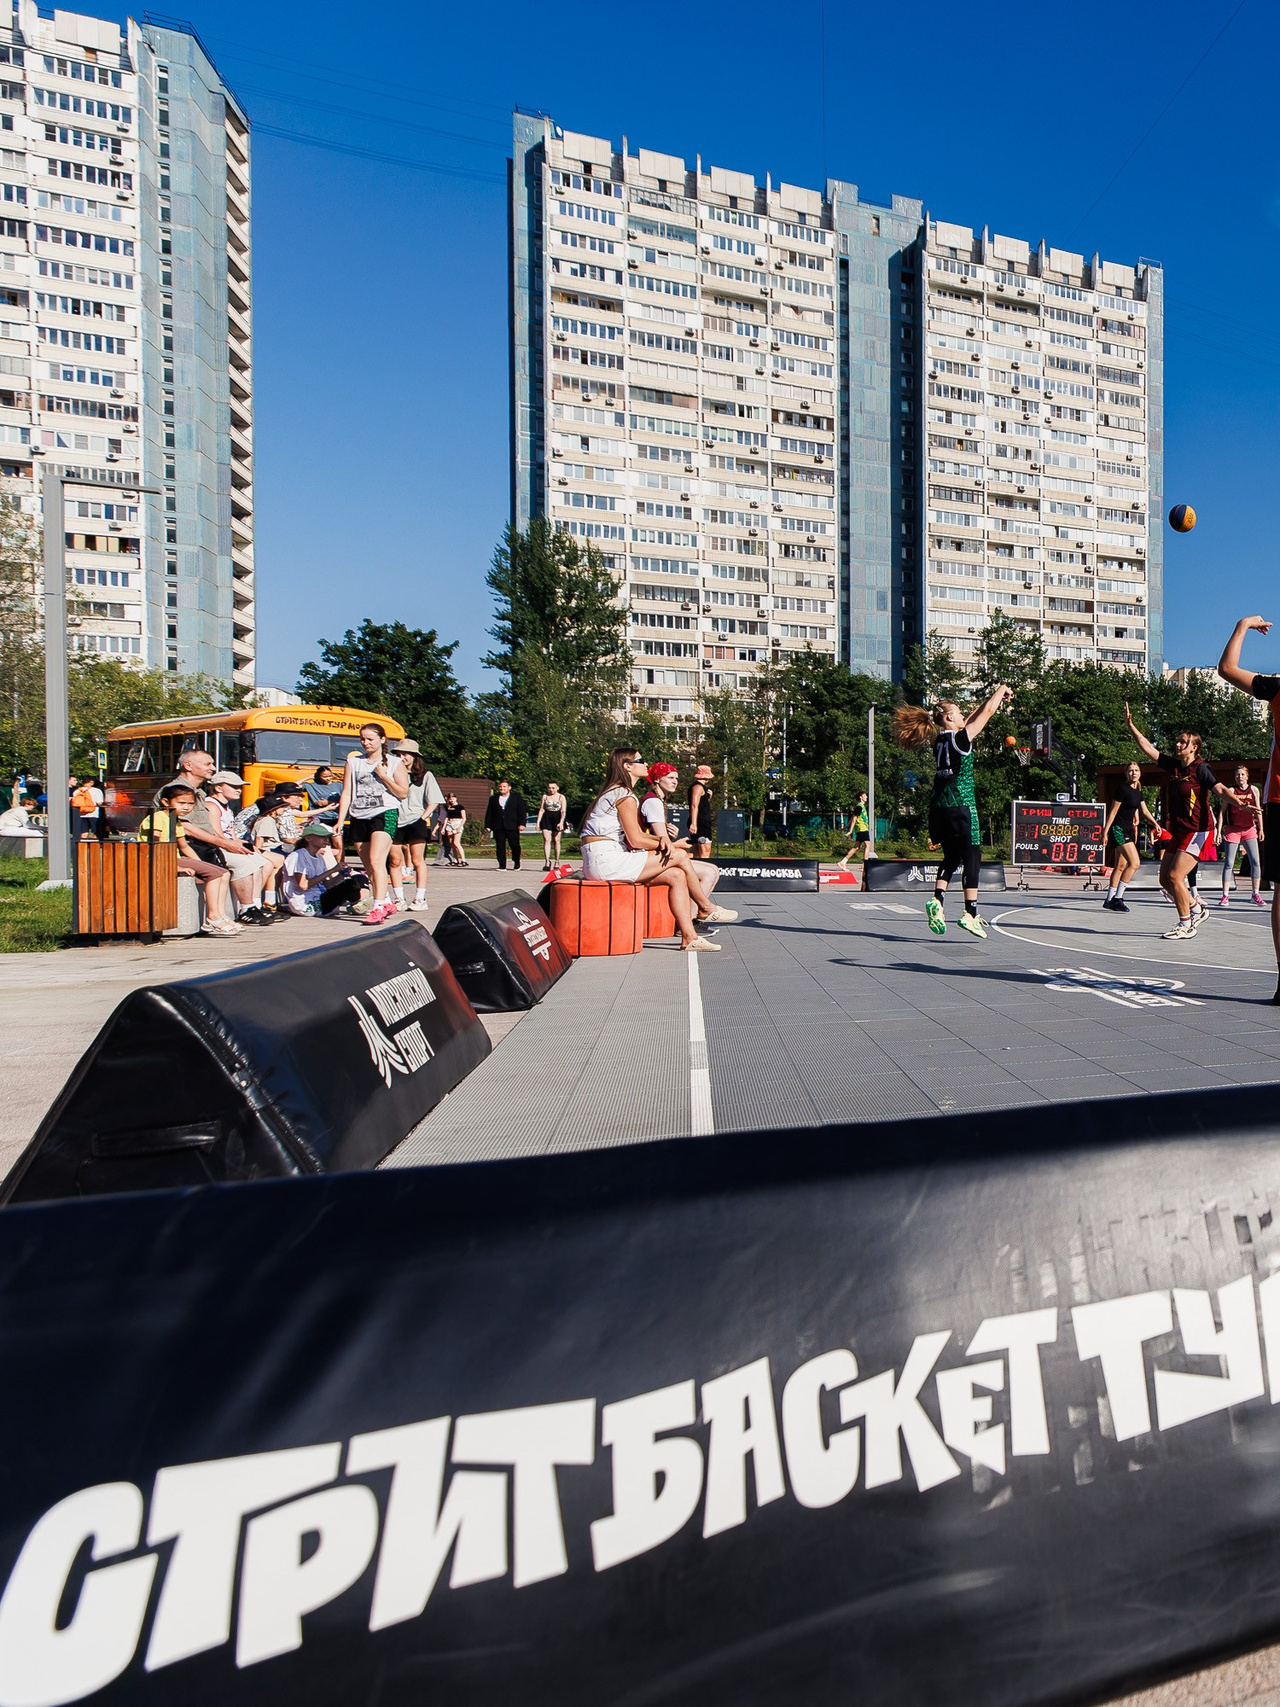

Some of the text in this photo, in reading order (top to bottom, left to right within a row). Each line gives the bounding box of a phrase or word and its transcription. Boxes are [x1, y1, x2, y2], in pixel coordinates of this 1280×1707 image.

[327, 720, 347, 729] ТУР
[1022, 808, 1098, 818] ТРИШ СТРМ
[1051, 817, 1071, 825] TIME
[1049, 835, 1072, 843] SHOT
[737, 867, 761, 878] ТУР
[761, 868, 802, 879] МОСКВА
[365, 961, 437, 1028] МОСКОВСКИЙ
[393, 1020, 435, 1073] СПОРТ
